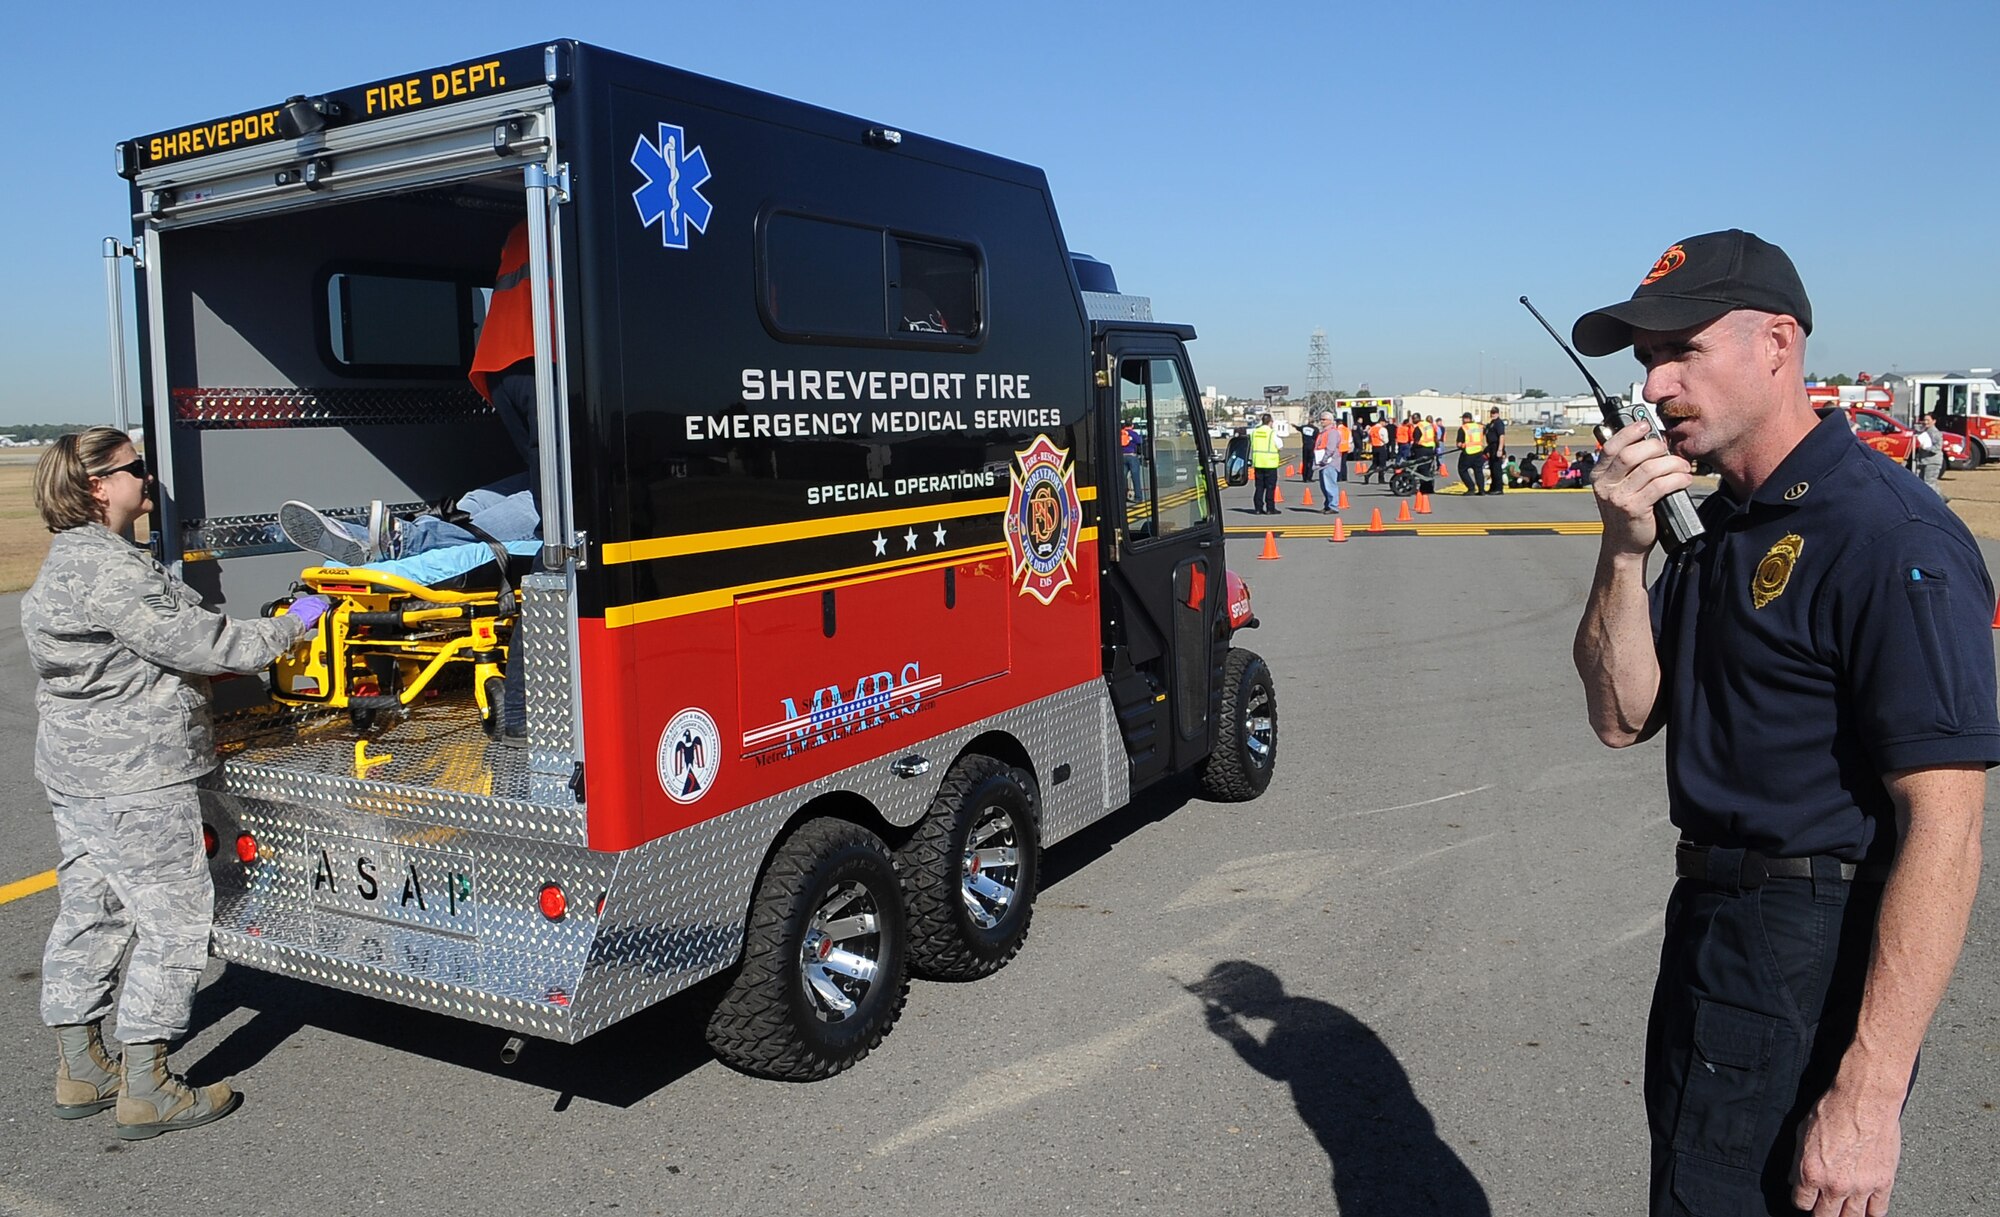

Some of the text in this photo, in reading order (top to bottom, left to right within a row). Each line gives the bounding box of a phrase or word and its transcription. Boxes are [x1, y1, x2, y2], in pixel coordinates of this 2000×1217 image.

[150, 60, 506, 161] SHREVEPOR FIRE DEPT.
[741, 368, 1031, 401] SHREVEPORT FIRE
[685, 408, 1061, 440] EMERGENCY MEDICAL SERVICES
[807, 471, 995, 505] SPECIAL OPERATIONS
[1025, 467, 1064, 496] SHREVEPORT
[1022, 532, 1068, 574] FIRE DEPARTMENT
[1039, 576, 1053, 588] EMS
